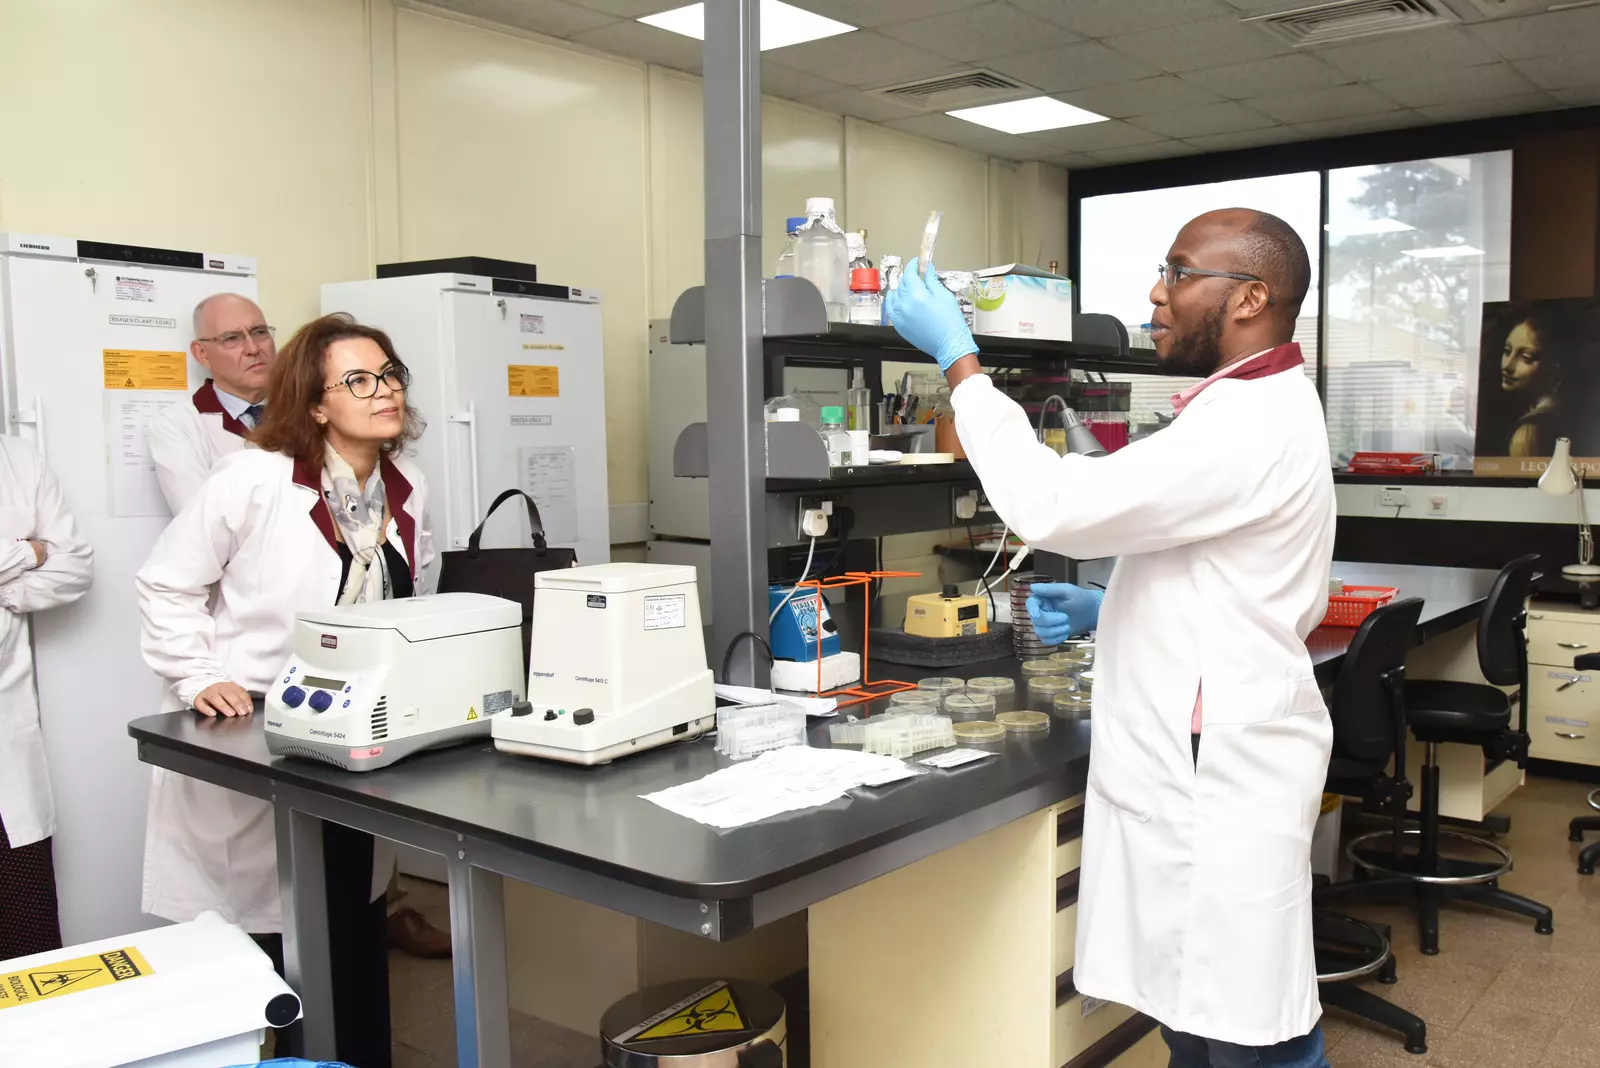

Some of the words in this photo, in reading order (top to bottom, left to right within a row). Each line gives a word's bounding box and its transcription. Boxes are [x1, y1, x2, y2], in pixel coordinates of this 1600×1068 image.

[1521, 461, 1600, 472] LEORDO
[575, 675, 594, 683] Centrifuge
[309, 728, 333, 738] Centrifuge
[103, 951, 136, 979] DANGER
[8, 975, 30, 1001] BIOLOGICAL
